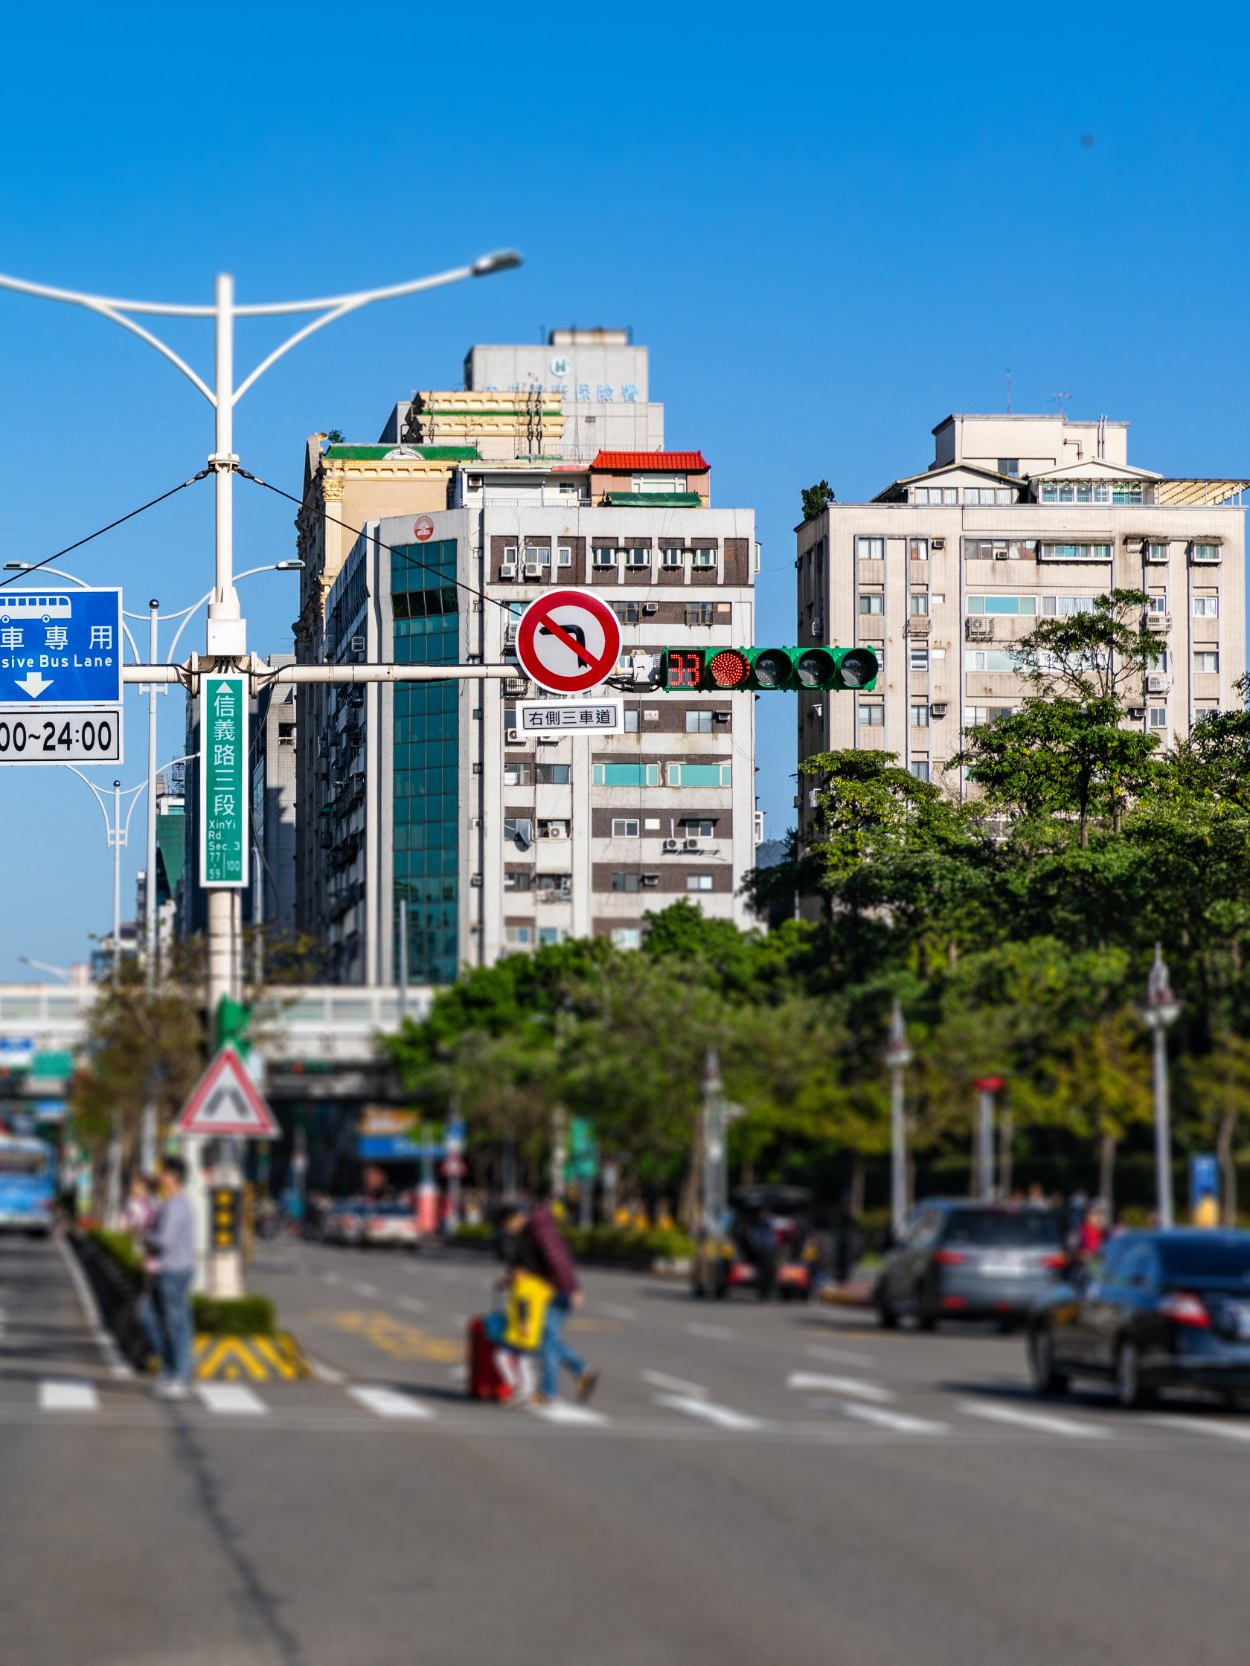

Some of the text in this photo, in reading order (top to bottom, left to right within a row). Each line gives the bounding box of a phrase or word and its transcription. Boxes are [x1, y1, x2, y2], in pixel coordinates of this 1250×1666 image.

[39, 654, 69, 668] Bus
[73, 654, 113, 668] Lane
[670, 654, 700, 686] 33
[528, 709, 611, 726] 右側三車道
[213, 695, 236, 817] 信義路三段
[208, 819, 236, 829] XinYi
[208, 831, 224, 840] Rd.
[208, 841, 241, 851] Sec. 3
[209, 852, 221, 863] 77
[226, 859, 241, 872] 100
[209, 868, 221, 880] 59
